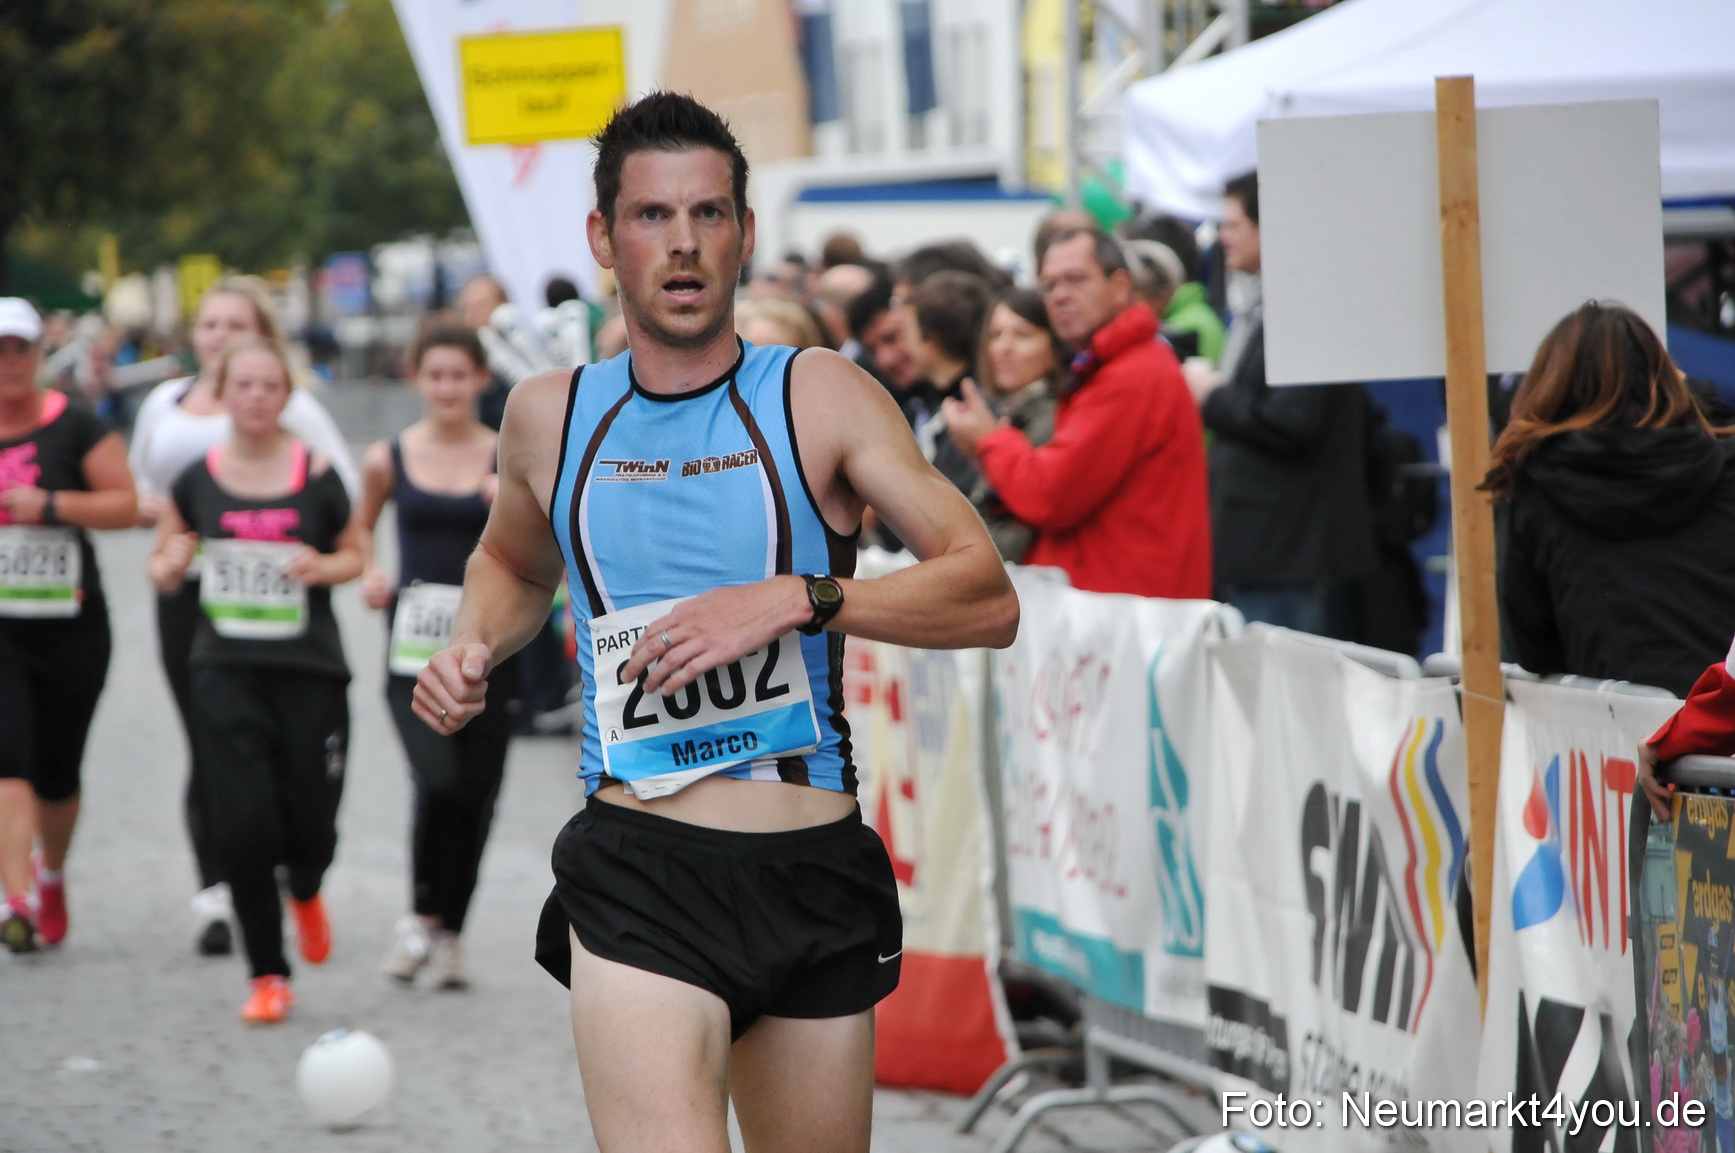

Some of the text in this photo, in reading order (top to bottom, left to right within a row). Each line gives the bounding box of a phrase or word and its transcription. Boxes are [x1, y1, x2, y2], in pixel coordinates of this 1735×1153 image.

[722, 449, 758, 470] RACER
[609, 729, 619, 741] A
[671, 731, 759, 766] Marco
[1693, 868, 1733, 933] erdgas
